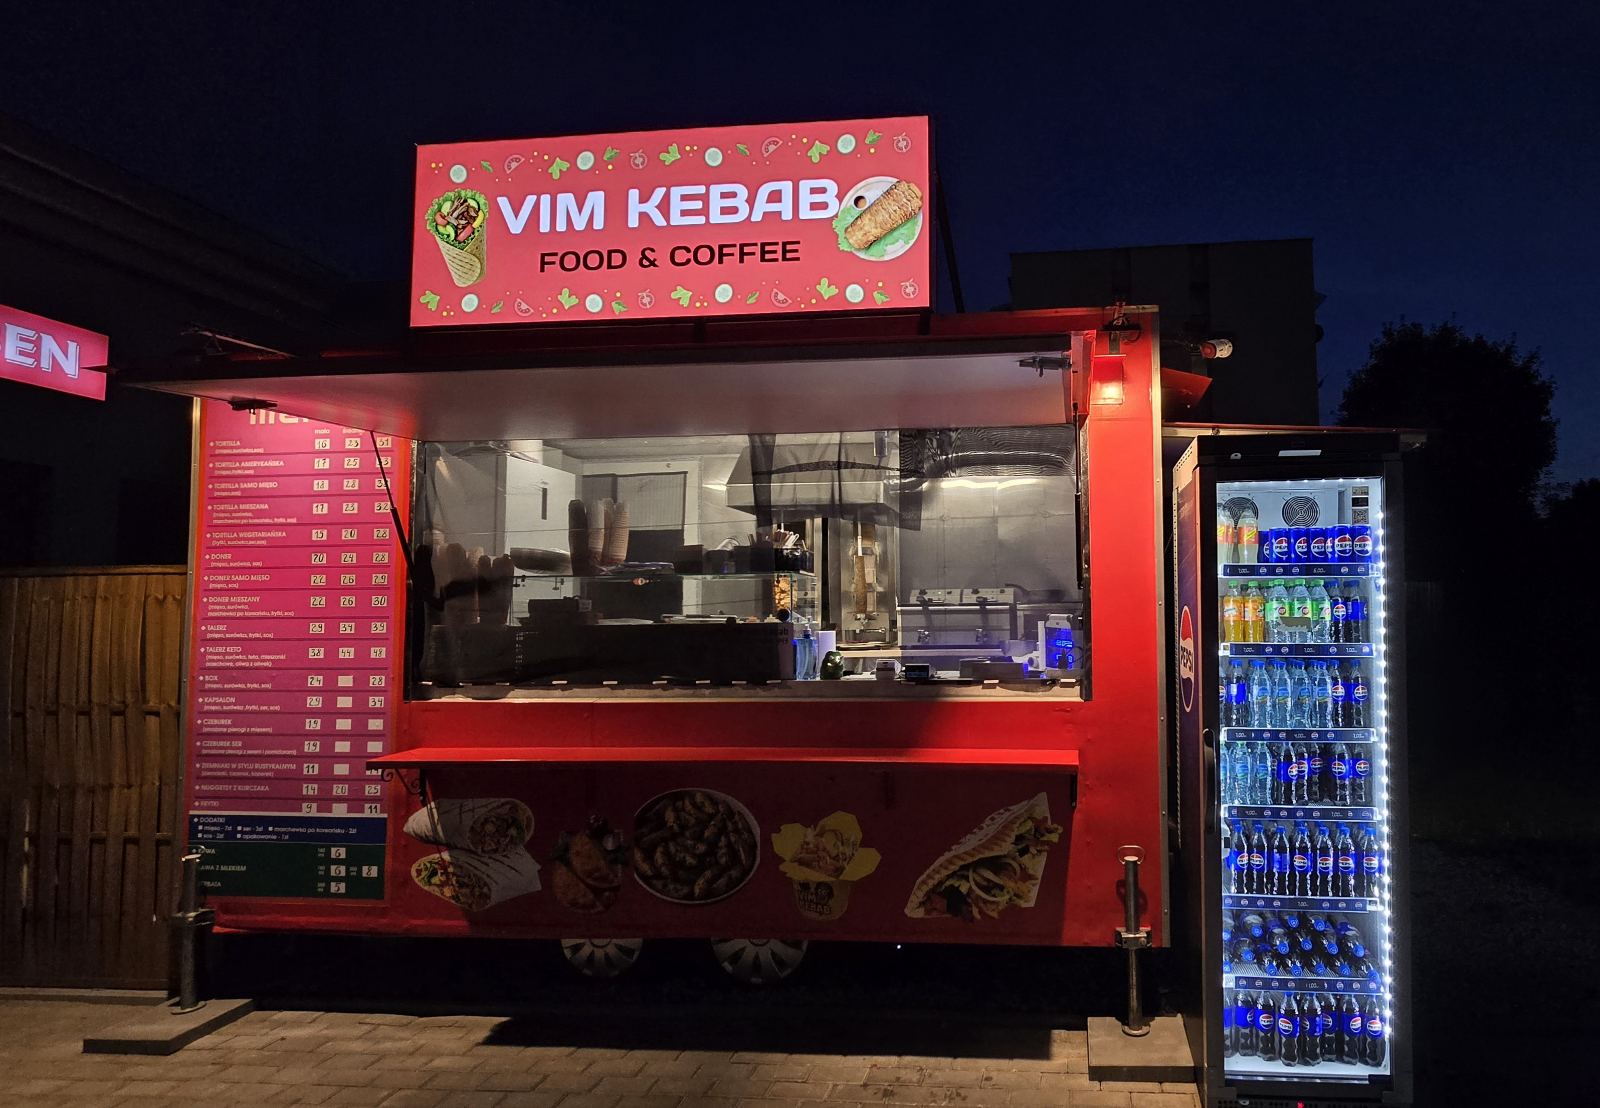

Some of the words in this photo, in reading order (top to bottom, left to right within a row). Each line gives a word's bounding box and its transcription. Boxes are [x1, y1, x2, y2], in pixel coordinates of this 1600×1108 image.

[496, 190, 605, 234] VIM
[628, 178, 840, 228] KEBAB
[540, 248, 628, 273] FOOD
[638, 246, 659, 268] &
[669, 240, 801, 267] COFFEE
[0, 322, 80, 379] EN
[346, 458, 358, 467] 25
[377, 457, 389, 466] 3
[344, 529, 356, 539] 20
[313, 553, 324, 563] 20
[343, 553, 354, 563] 24
[375, 553, 386, 562] 28
[313, 575, 326, 584] 22
[342, 575, 355, 584] 26
[373, 574, 386, 584] 29
[312, 596, 325, 606] 22
[342, 596, 354, 606] 26
[373, 596, 386, 606] 30
[341, 623, 353, 632] 34
[372, 622, 385, 632] 39
[311, 648, 322, 657] 38
[341, 649, 351, 658] 44
[373, 648, 383, 658] 48
[309, 676, 321, 686] 24
[371, 676, 383, 686] 28
[370, 697, 383, 707] 34
[305, 764, 315, 773] 11
[304, 785, 316, 794] 14
[335, 785, 346, 795] 20
[367, 785, 379, 795] 25
[306, 803, 313, 813] 9
[367, 804, 378, 814] 11
[334, 848, 342, 858] 6
[334, 866, 342, 876] 6
[334, 882, 342, 892] 5
